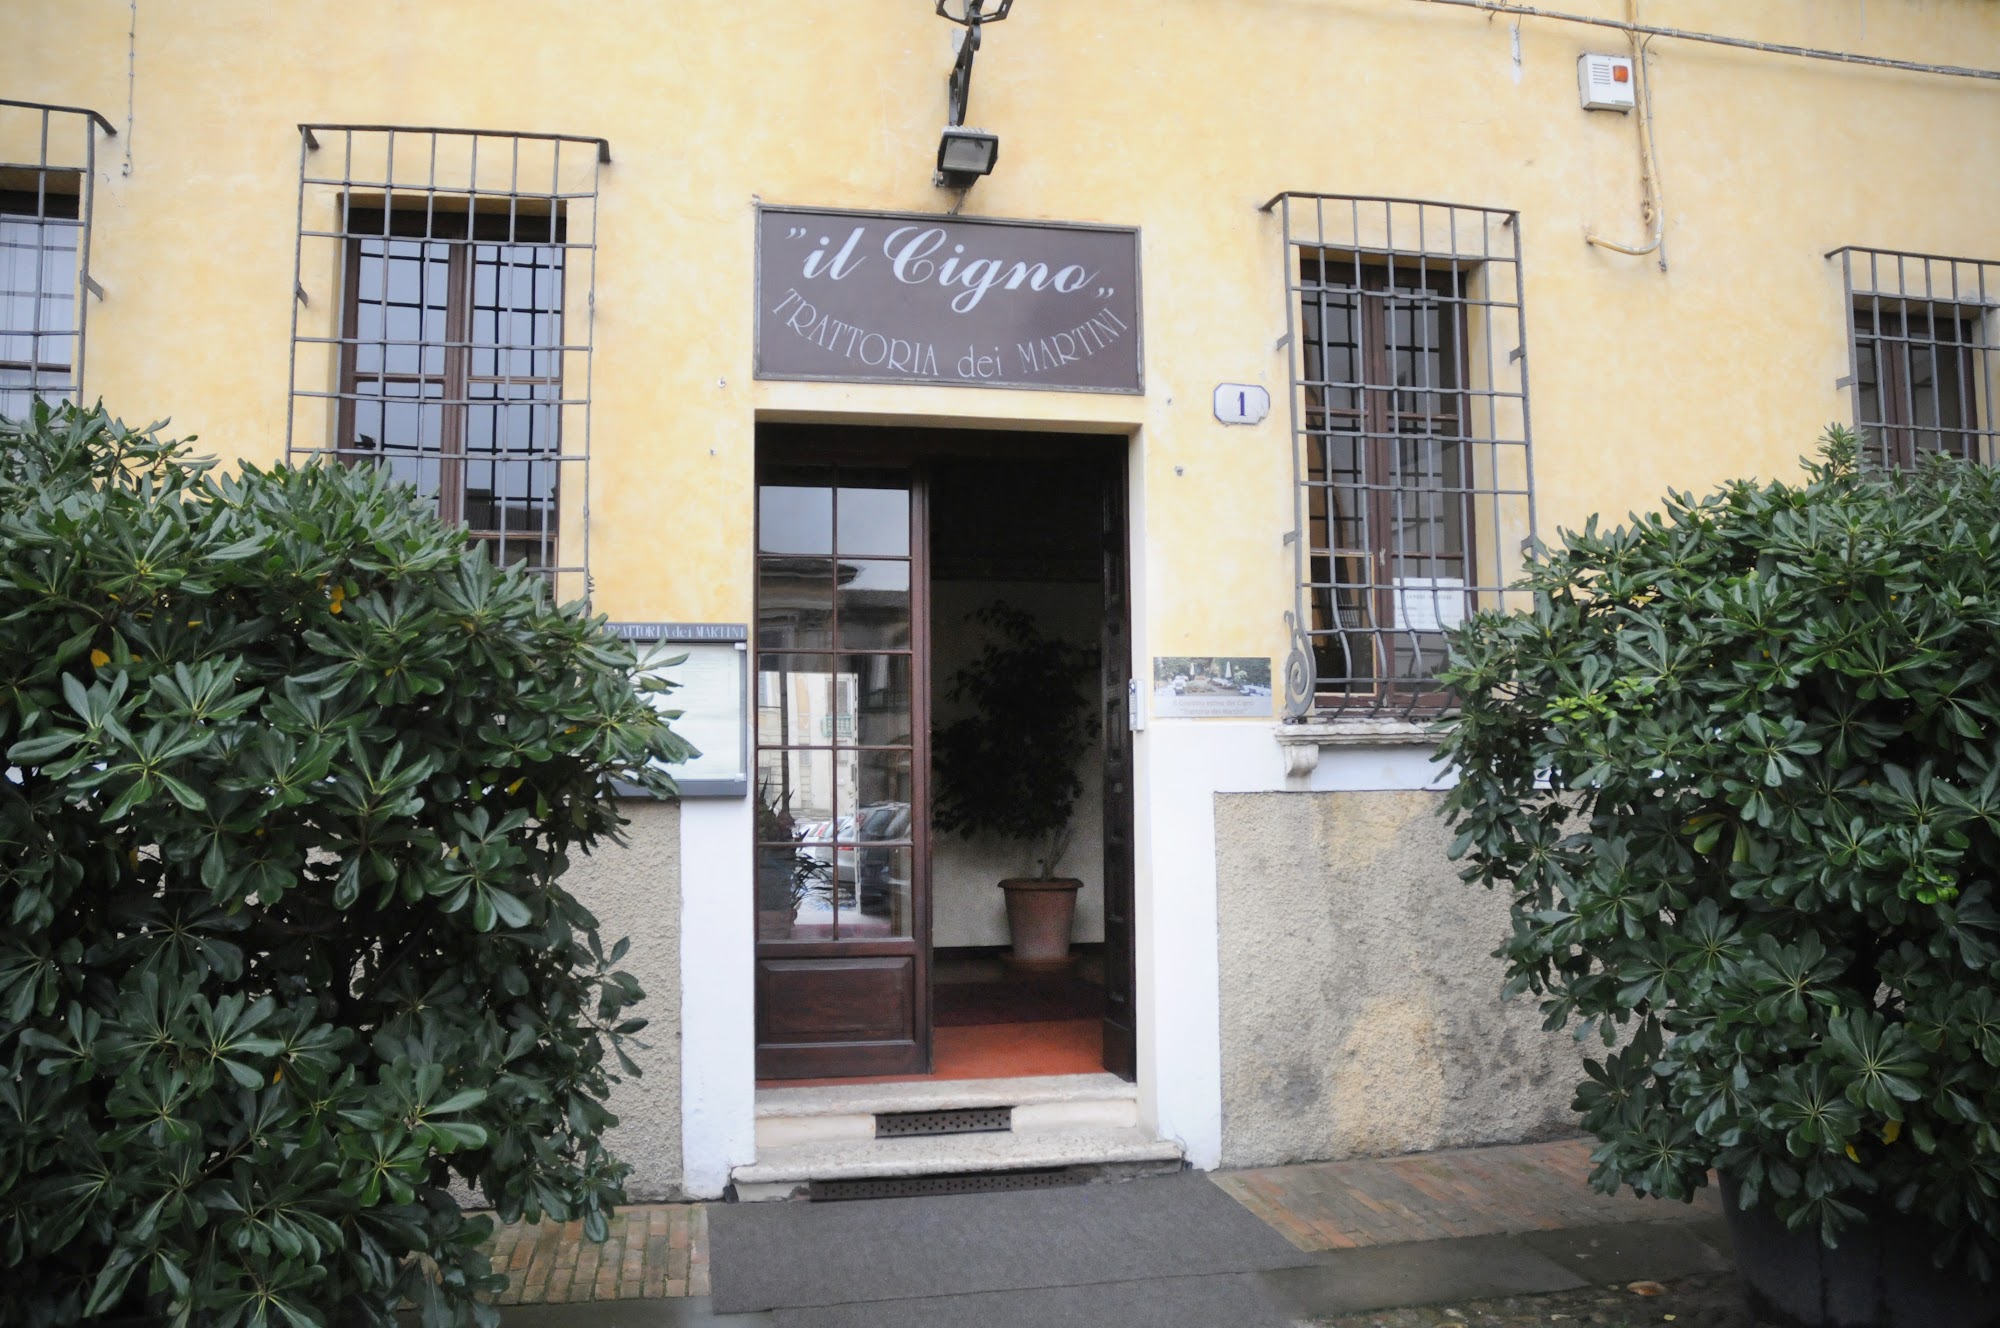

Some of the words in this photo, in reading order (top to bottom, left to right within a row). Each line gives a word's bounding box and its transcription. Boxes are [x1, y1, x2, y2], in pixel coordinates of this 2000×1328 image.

[771, 287, 939, 376] TRATTORIA
[957, 344, 1003, 378] dei
[1016, 307, 1128, 374] MARTINI
[1237, 391, 1246, 417] 1
[672, 625, 692, 638] dei
[695, 625, 744, 639] MARTINI
